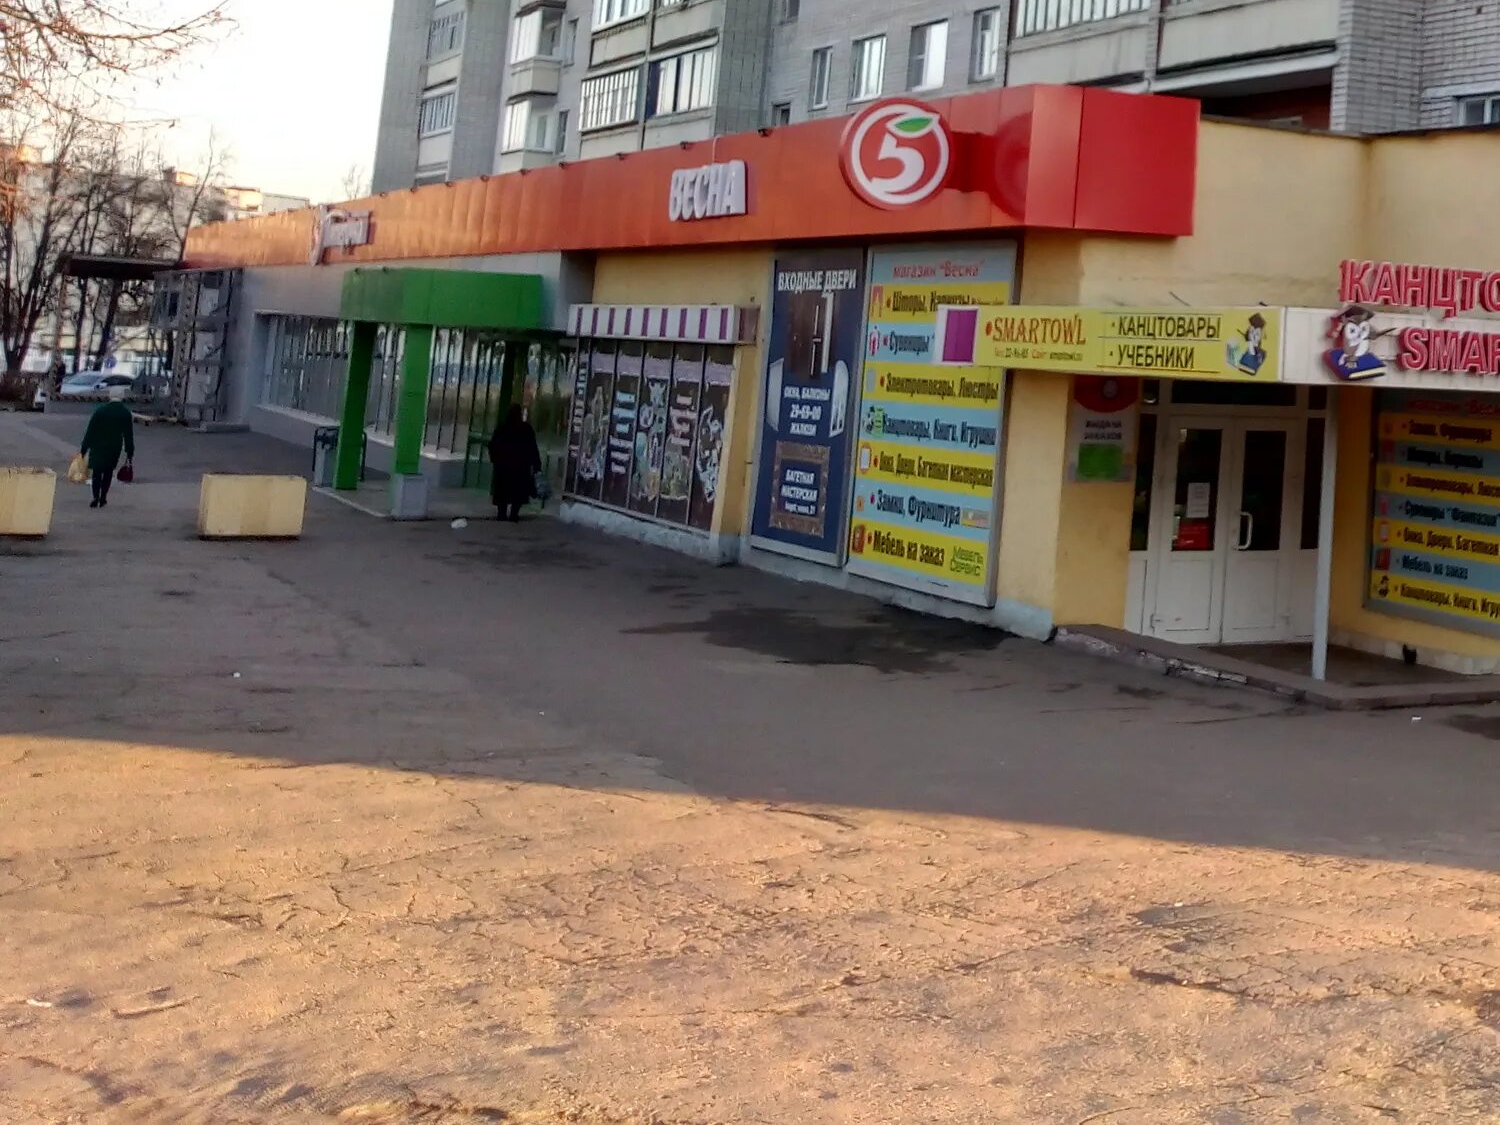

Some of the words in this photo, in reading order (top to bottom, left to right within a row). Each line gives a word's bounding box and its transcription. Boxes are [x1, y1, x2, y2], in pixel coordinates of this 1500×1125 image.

[669, 159, 748, 222] ВЕСНА
[778, 271, 823, 294] ВХОДНЫЕ
[823, 268, 857, 292] ДВЕРИ
[992, 313, 1087, 344] SMARTOWL
[1118, 315, 1221, 339] КАНЦТОВАРЫ
[1118, 344, 1196, 369] УЧЕБНИКИ
[908, 495, 961, 528] Фурнитура
[873, 530, 905, 558] Мебель
[907, 540, 918, 561] на
[919, 543, 945, 567] заказ
